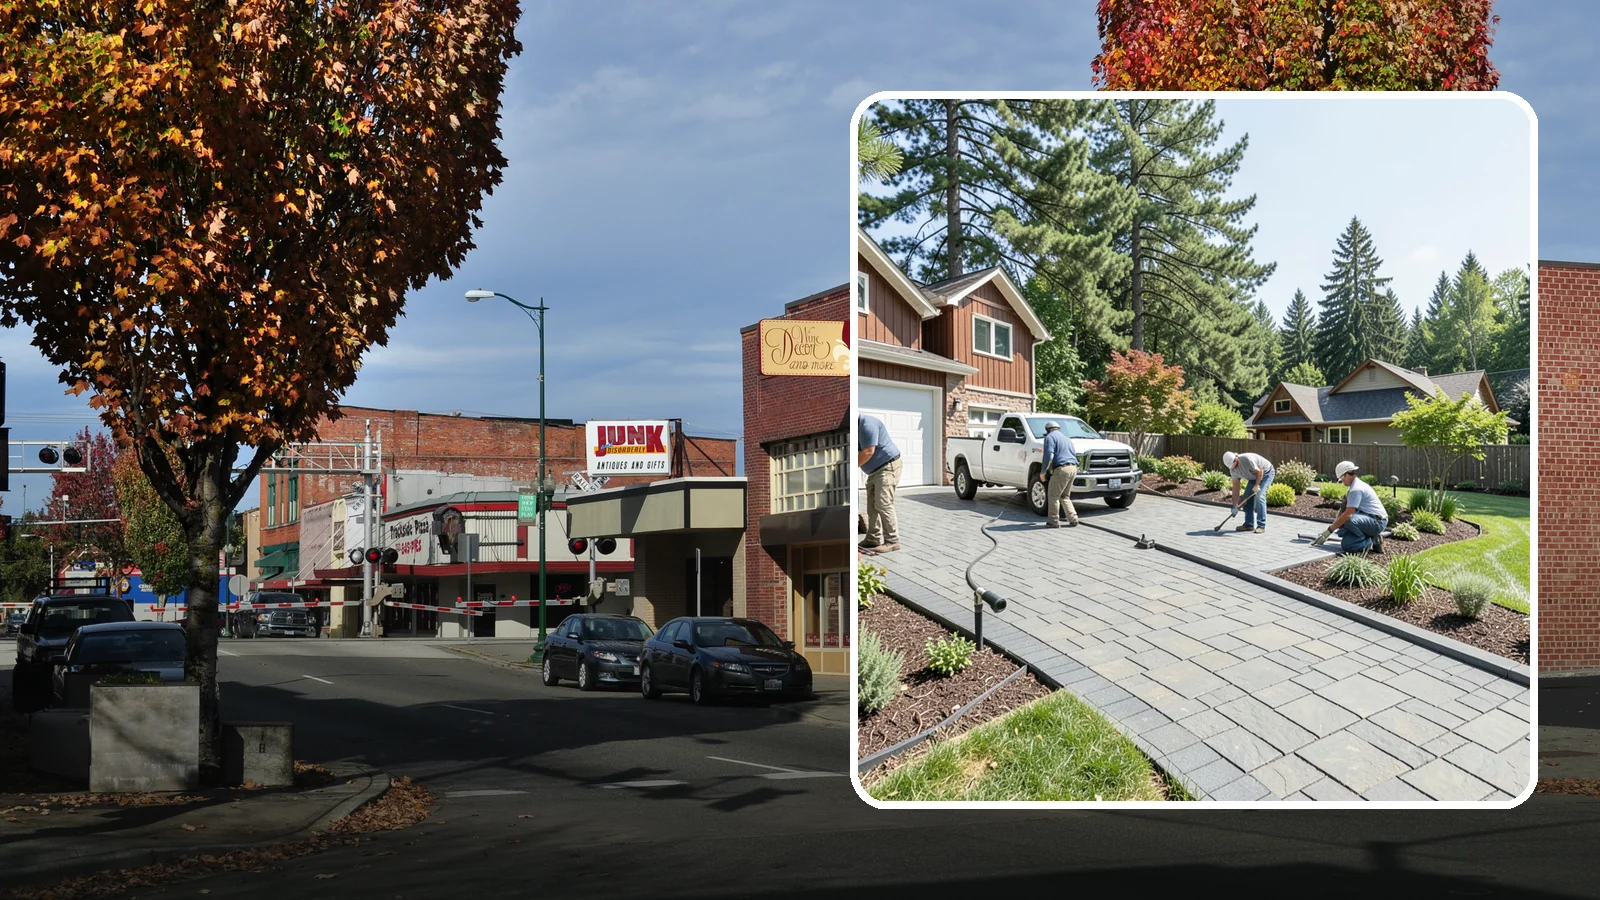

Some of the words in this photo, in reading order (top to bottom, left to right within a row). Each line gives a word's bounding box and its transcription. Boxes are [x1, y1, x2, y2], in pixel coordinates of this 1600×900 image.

[595, 425, 665, 457] JUNK
[607, 446, 646, 454] DISORDERLY
[597, 461, 628, 470] ANTIQUES
[631, 461, 644, 470] AND
[647, 460, 665, 469] GIFTS
[352, 498, 365, 511] CRO
[414, 519, 430, 535] Pizza
